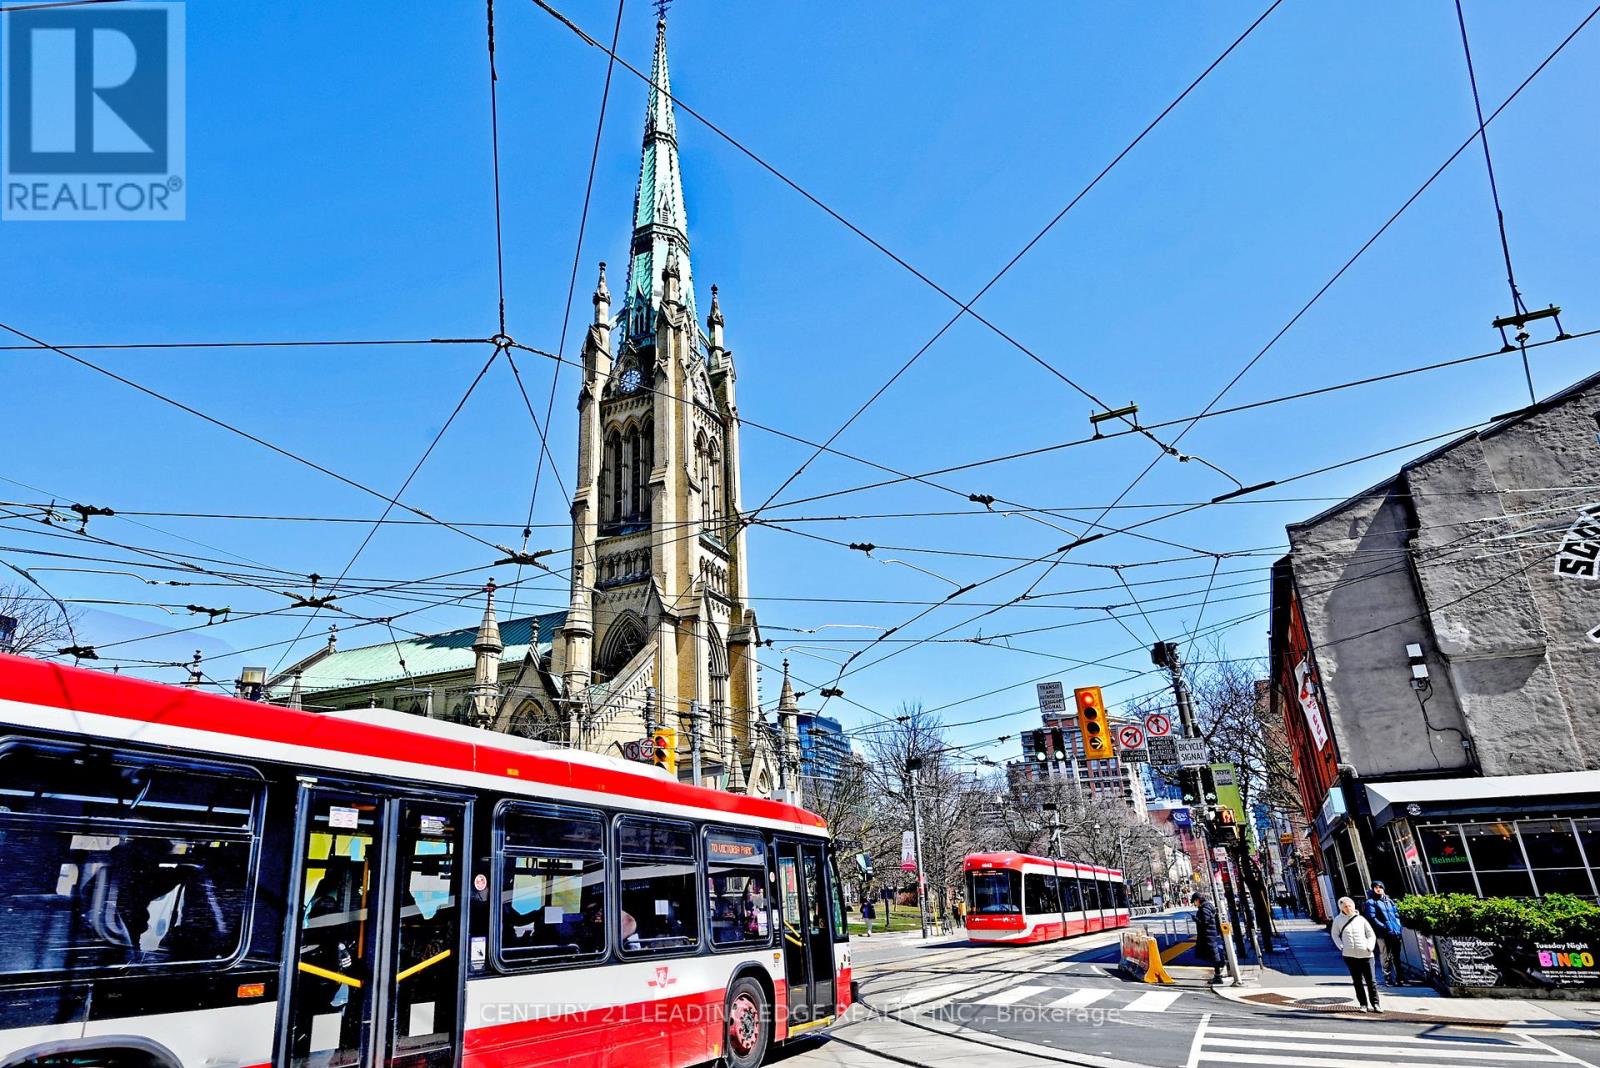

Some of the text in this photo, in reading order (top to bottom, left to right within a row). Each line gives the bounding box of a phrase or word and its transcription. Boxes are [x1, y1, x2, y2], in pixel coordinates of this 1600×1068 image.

[1178, 742, 1203, 751] BICYCLE
[1181, 753, 1204, 761] SIGNAL
[1534, 942, 1589, 950] Tuesday Night
[1538, 951, 1594, 967] BINGO
